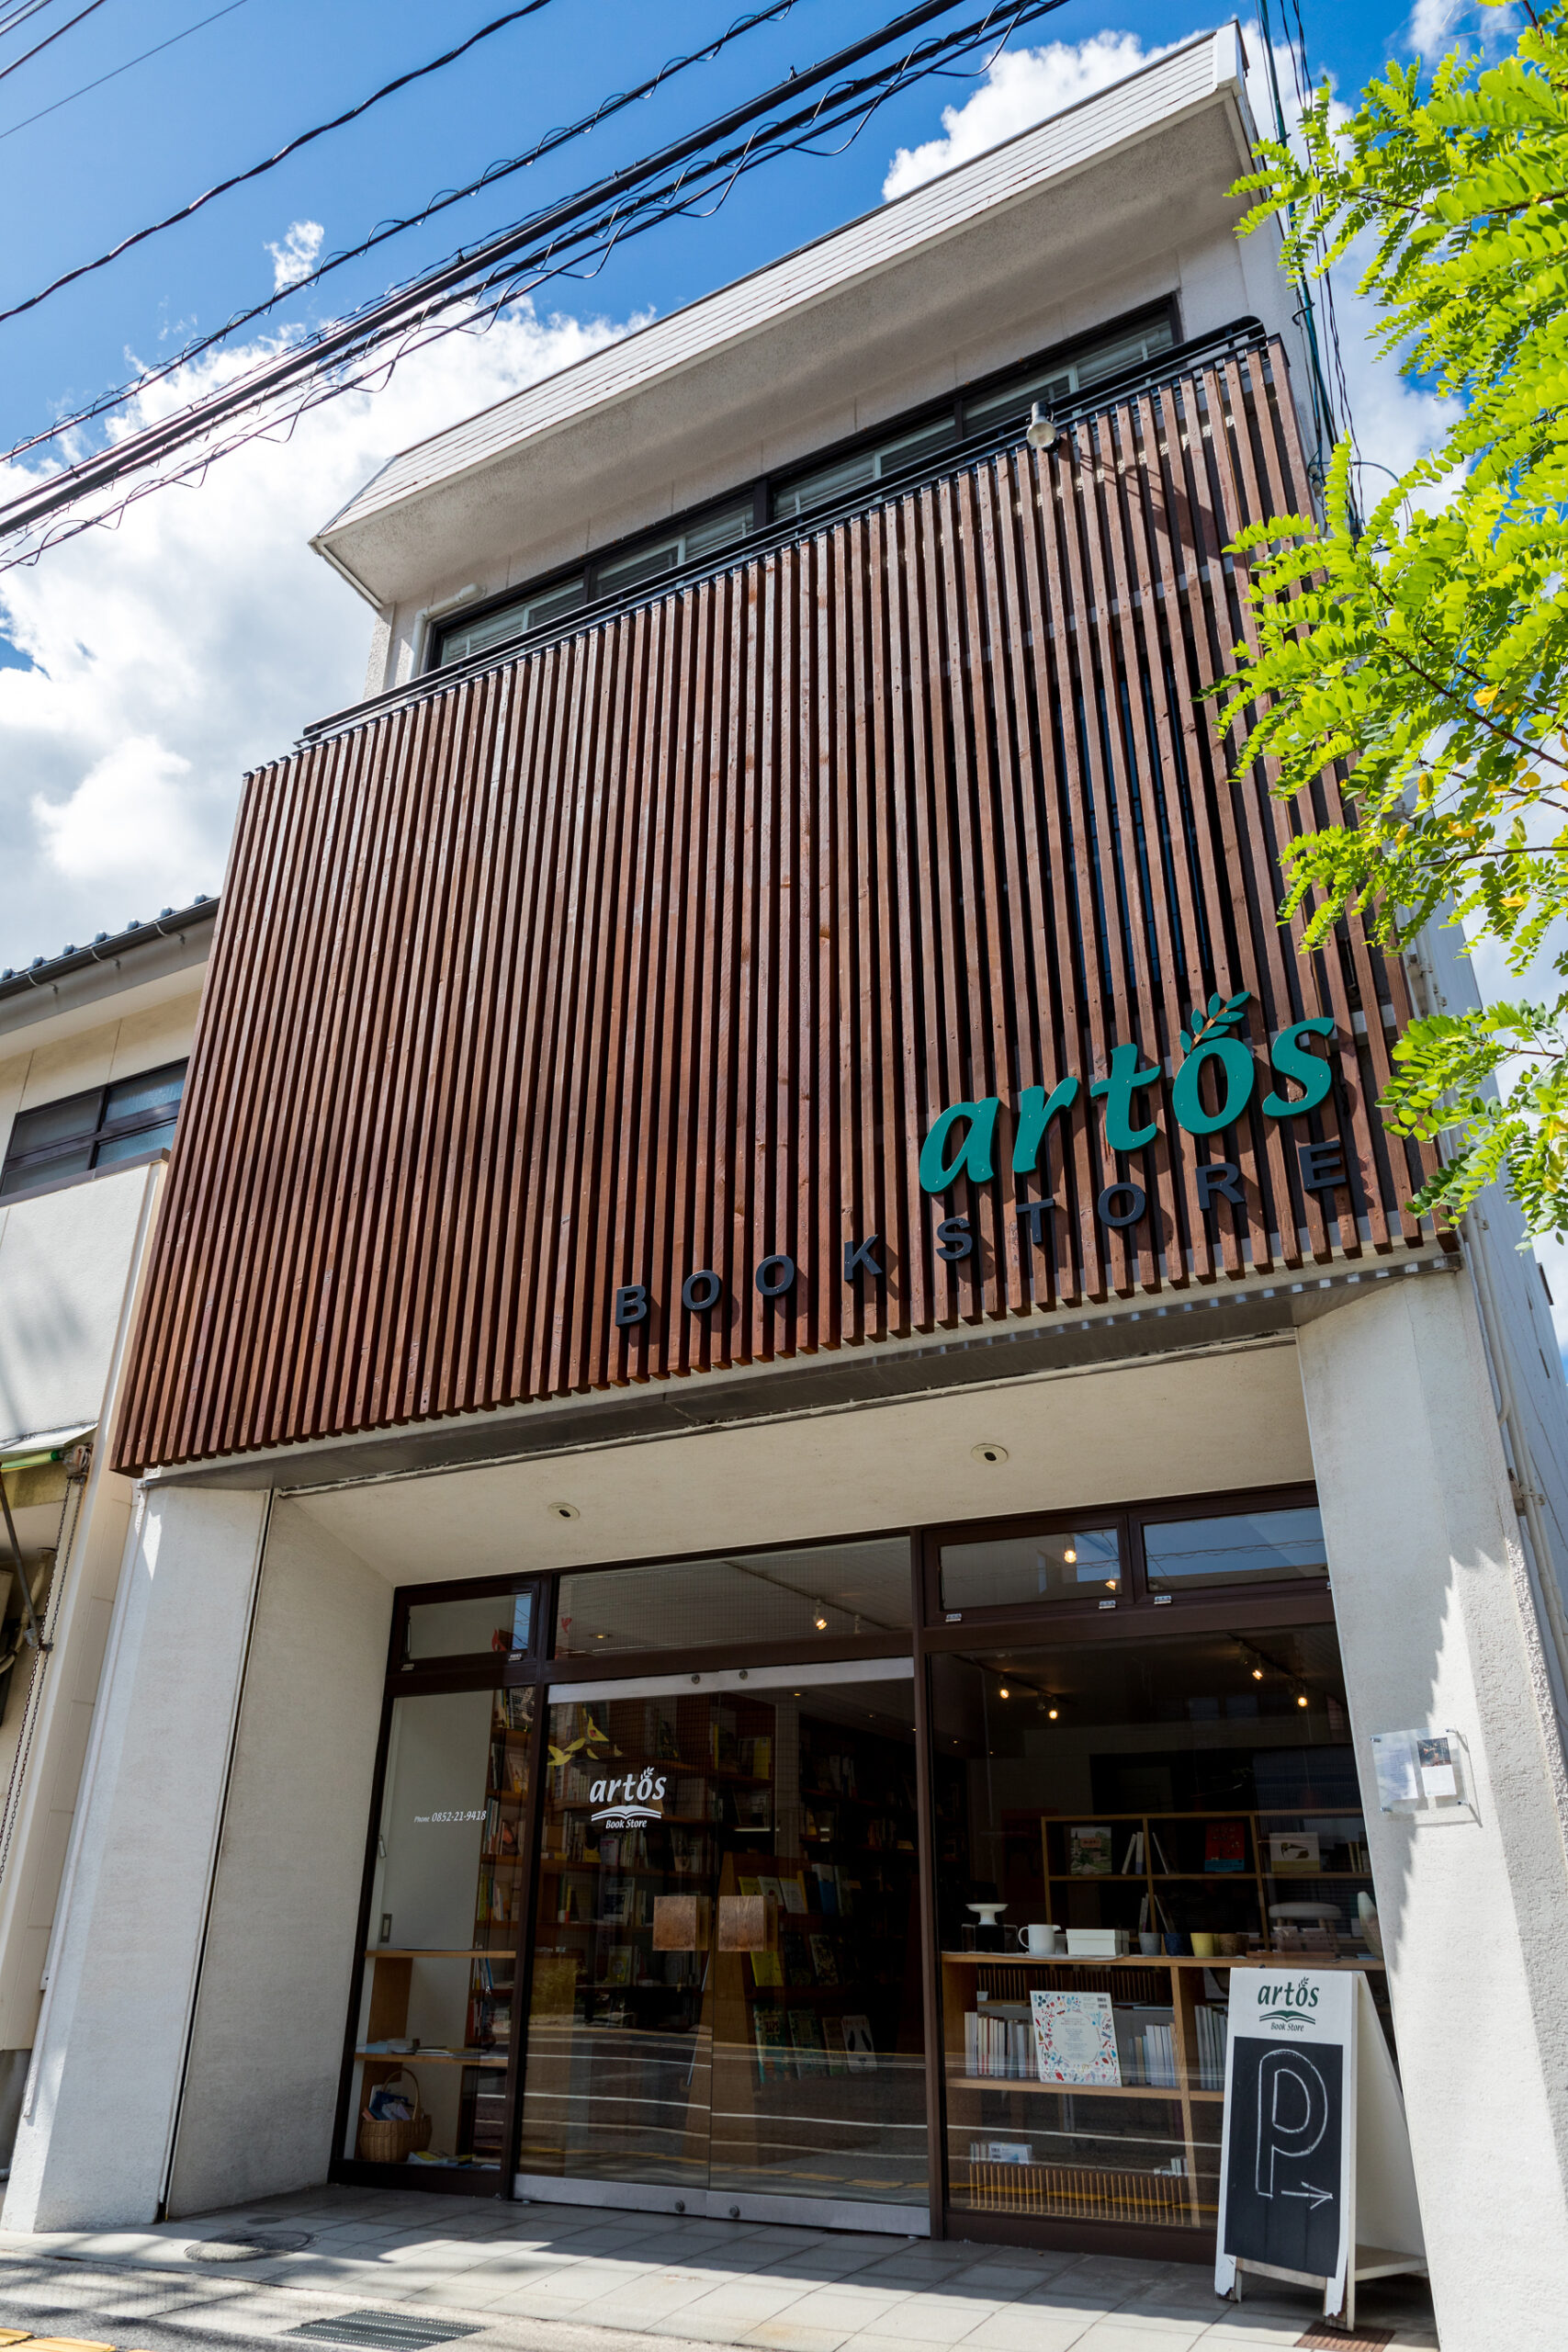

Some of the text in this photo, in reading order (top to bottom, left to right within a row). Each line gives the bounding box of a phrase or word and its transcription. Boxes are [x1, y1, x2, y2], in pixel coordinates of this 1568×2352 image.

[615, 1140, 1347, 1327] BOOK STORE
[431, 1810, 487, 1823] 0852-21-9418
[605, 1818, 648, 1829] Book Store
[1270, 2021, 1304, 2032] Book Store
[1255, 2049, 1328, 2199] P
